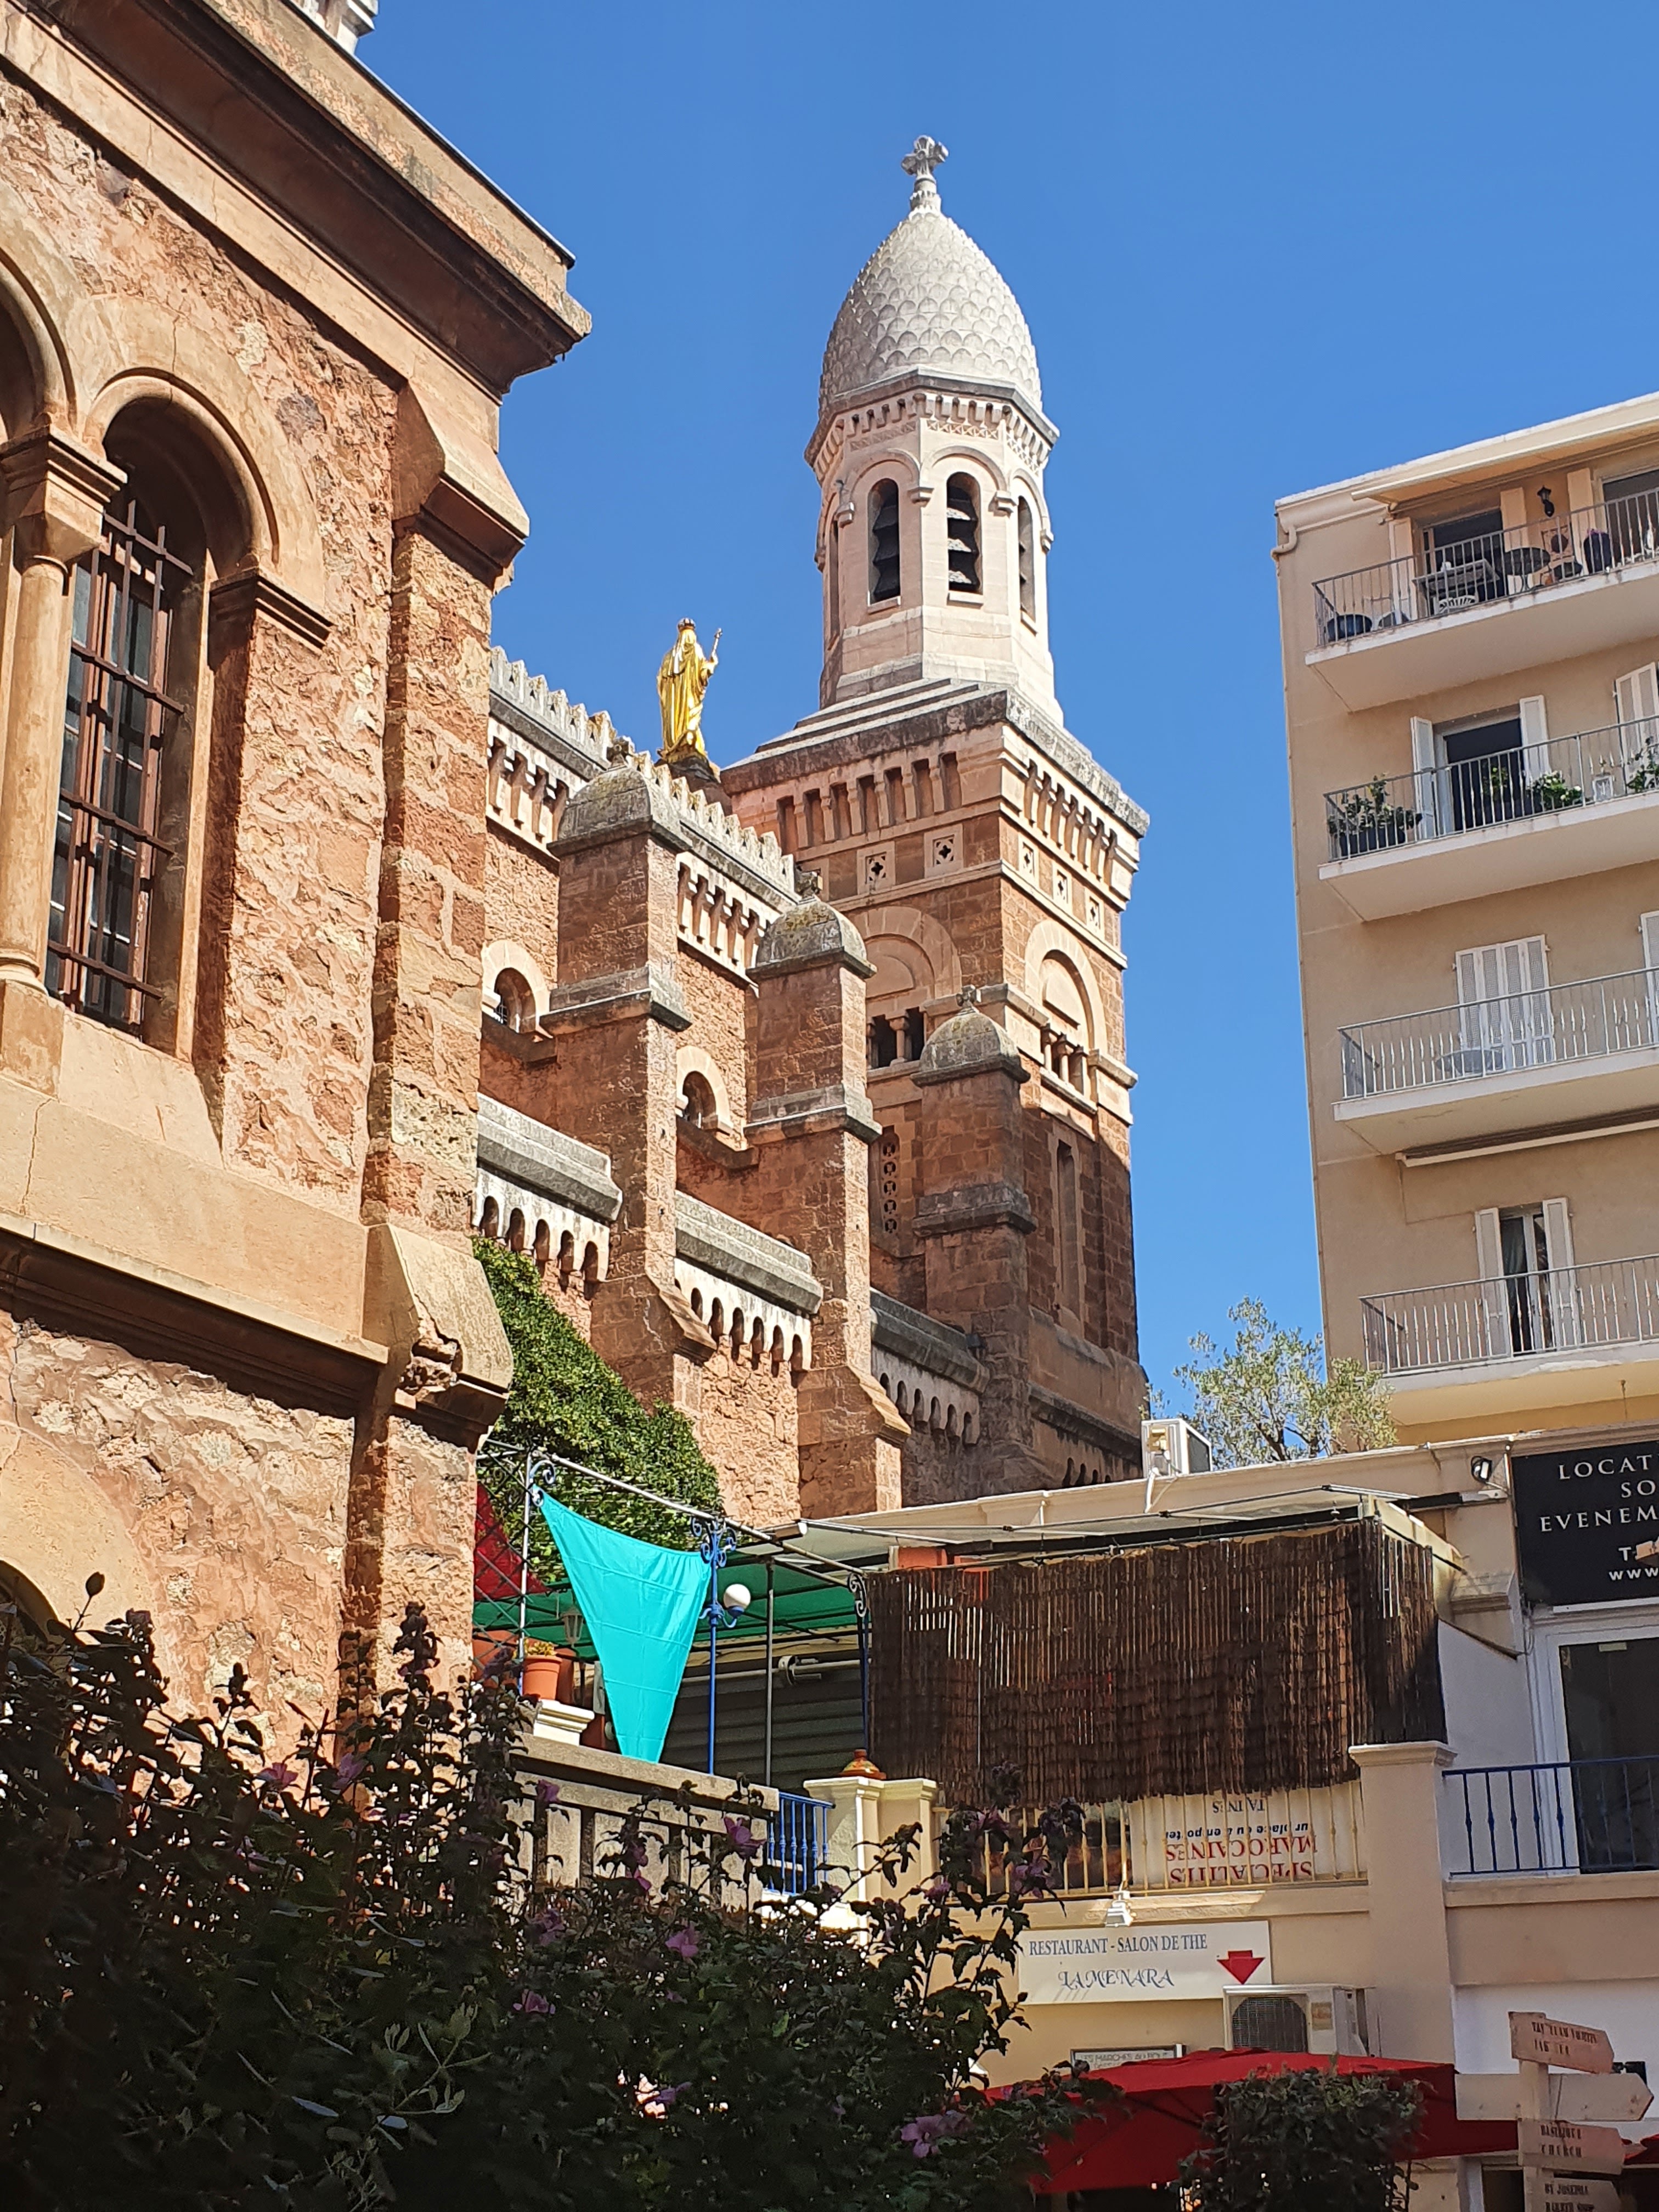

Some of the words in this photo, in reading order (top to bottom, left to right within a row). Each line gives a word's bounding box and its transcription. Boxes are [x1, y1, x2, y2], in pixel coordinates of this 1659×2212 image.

[1029, 1938, 1108, 1955] RESTAURANT
[1118, 1936, 1158, 1953] SALON
[1161, 1935, 1179, 1950] DE
[1181, 1934, 1207, 1949] THE
